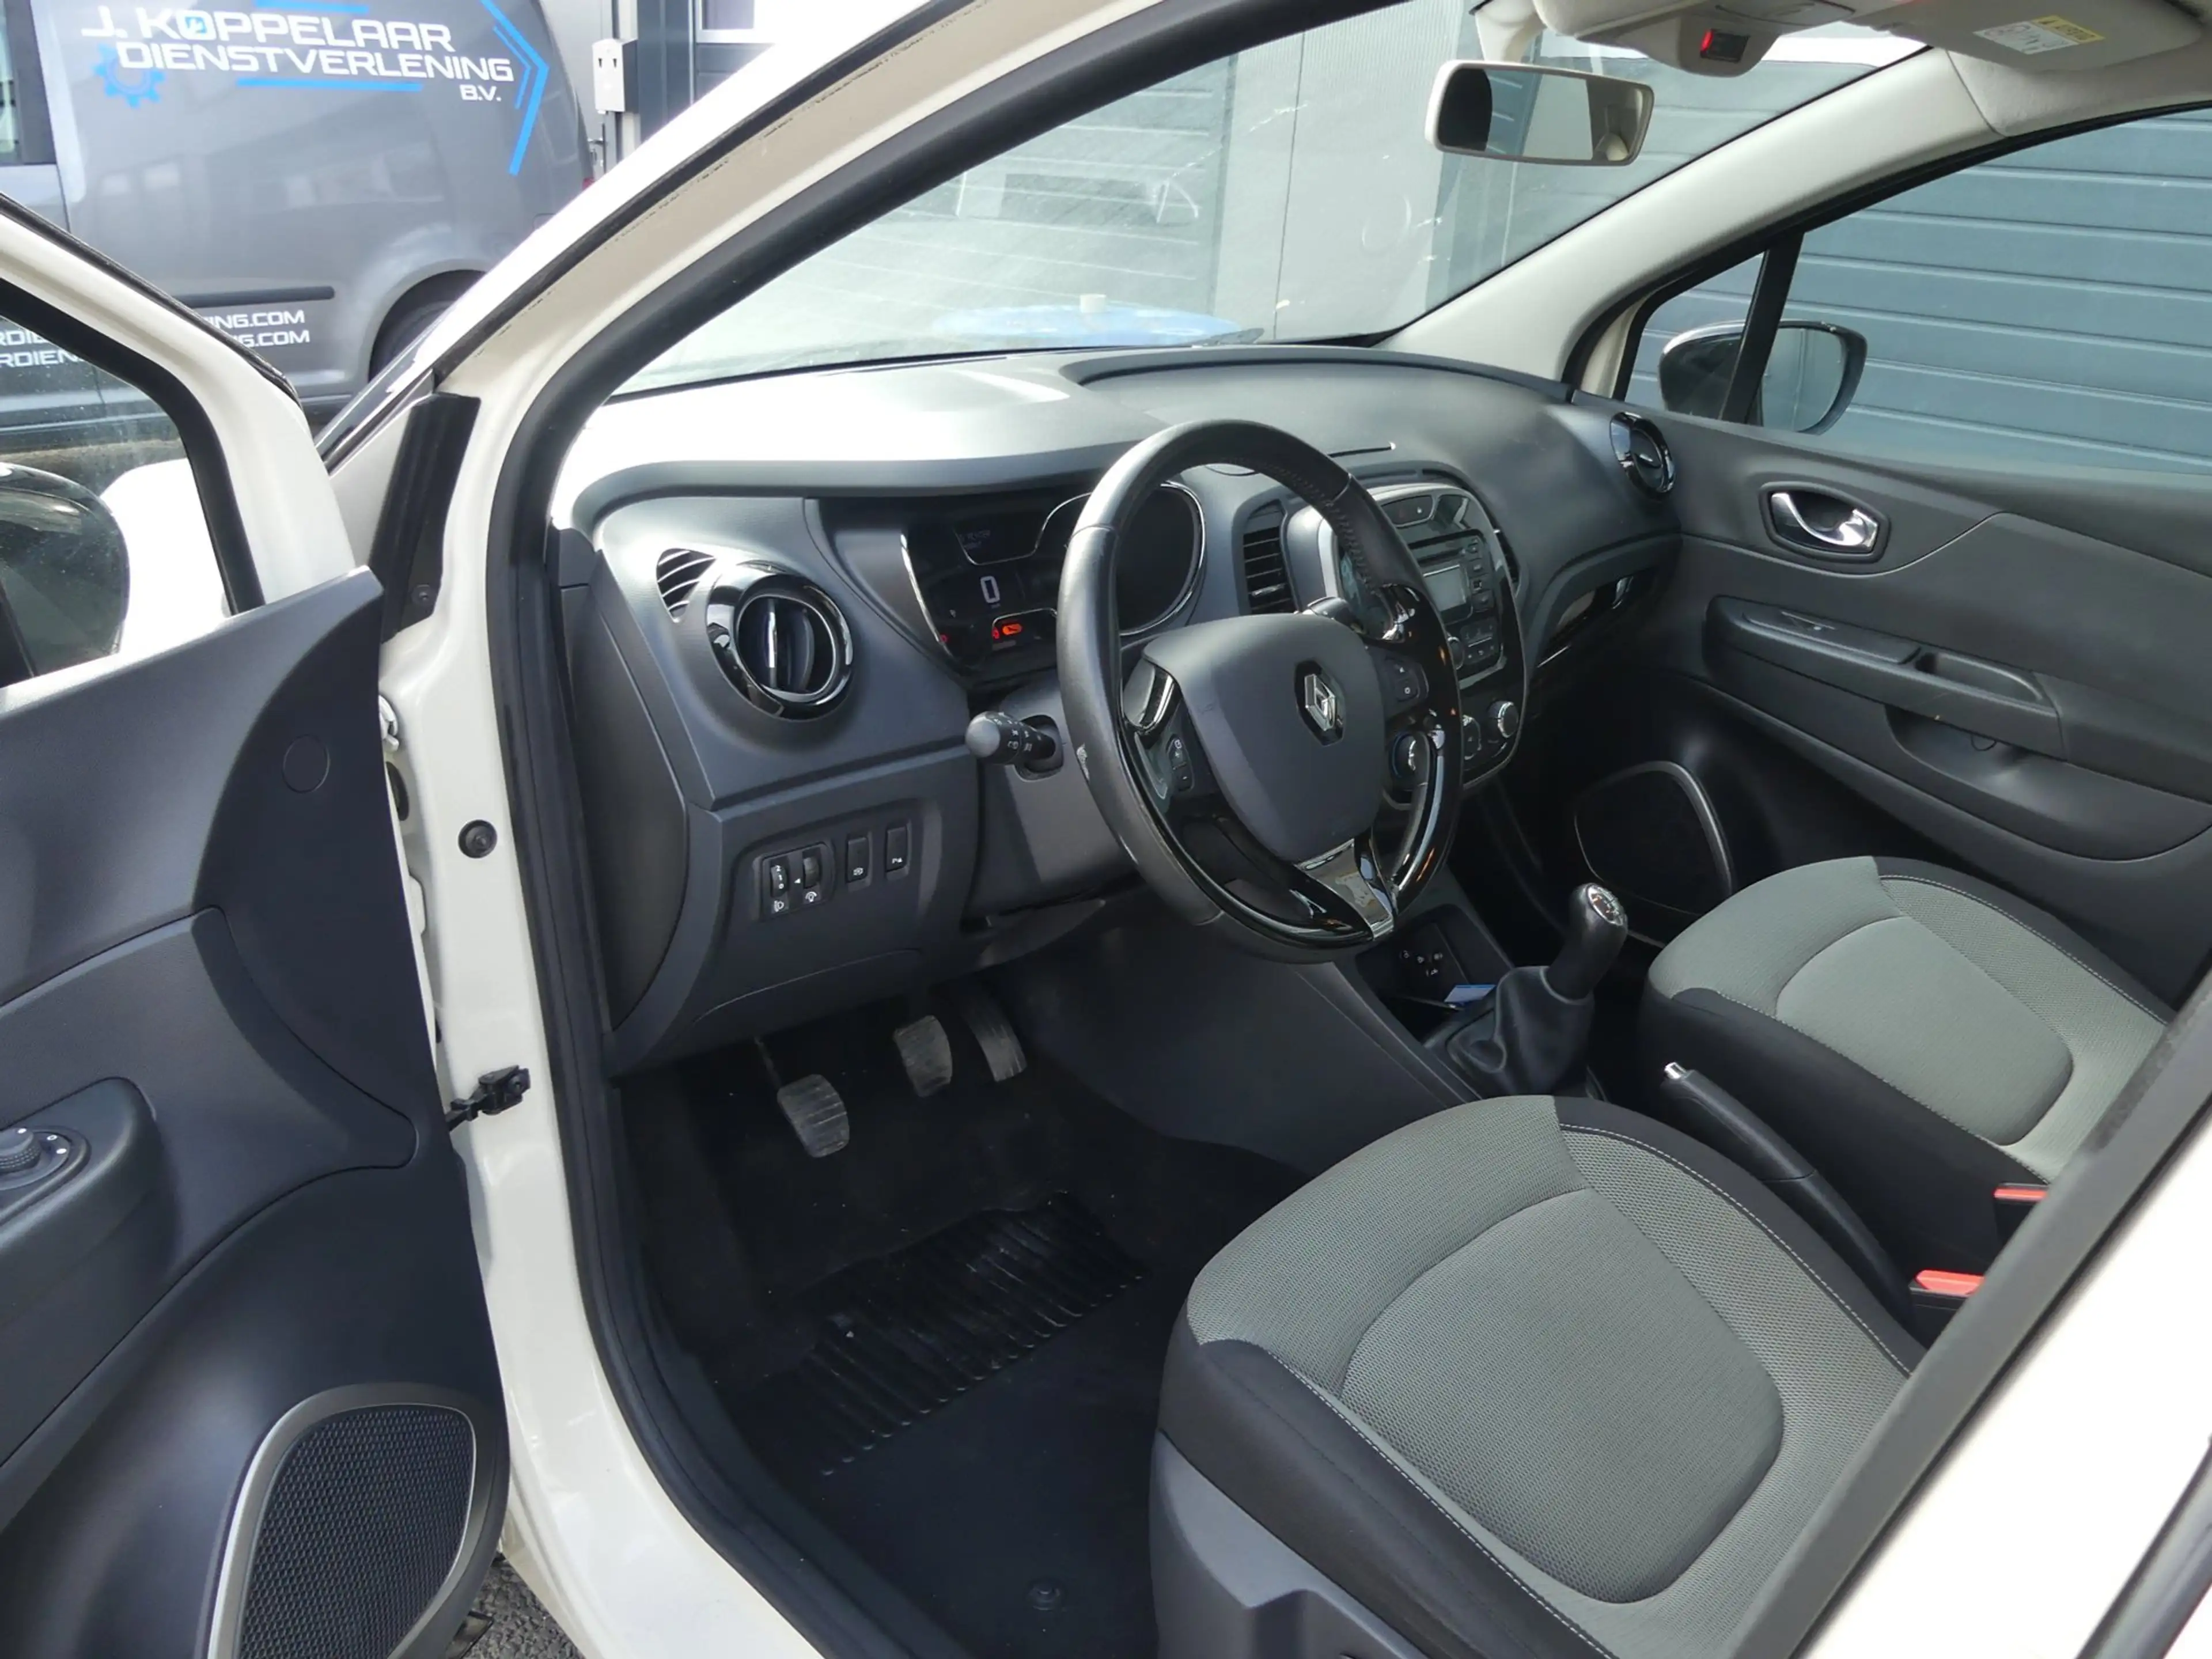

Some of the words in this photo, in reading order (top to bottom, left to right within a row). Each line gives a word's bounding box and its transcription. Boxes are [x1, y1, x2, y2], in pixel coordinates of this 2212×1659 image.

[81, 5, 128, 38] J.
[135, 7, 456, 52] KOPPELAAR
[116, 41, 514, 82] DIENSTVERLENING
[459, 84, 502, 101] B.V.
[980, 576, 1000, 603] 0
